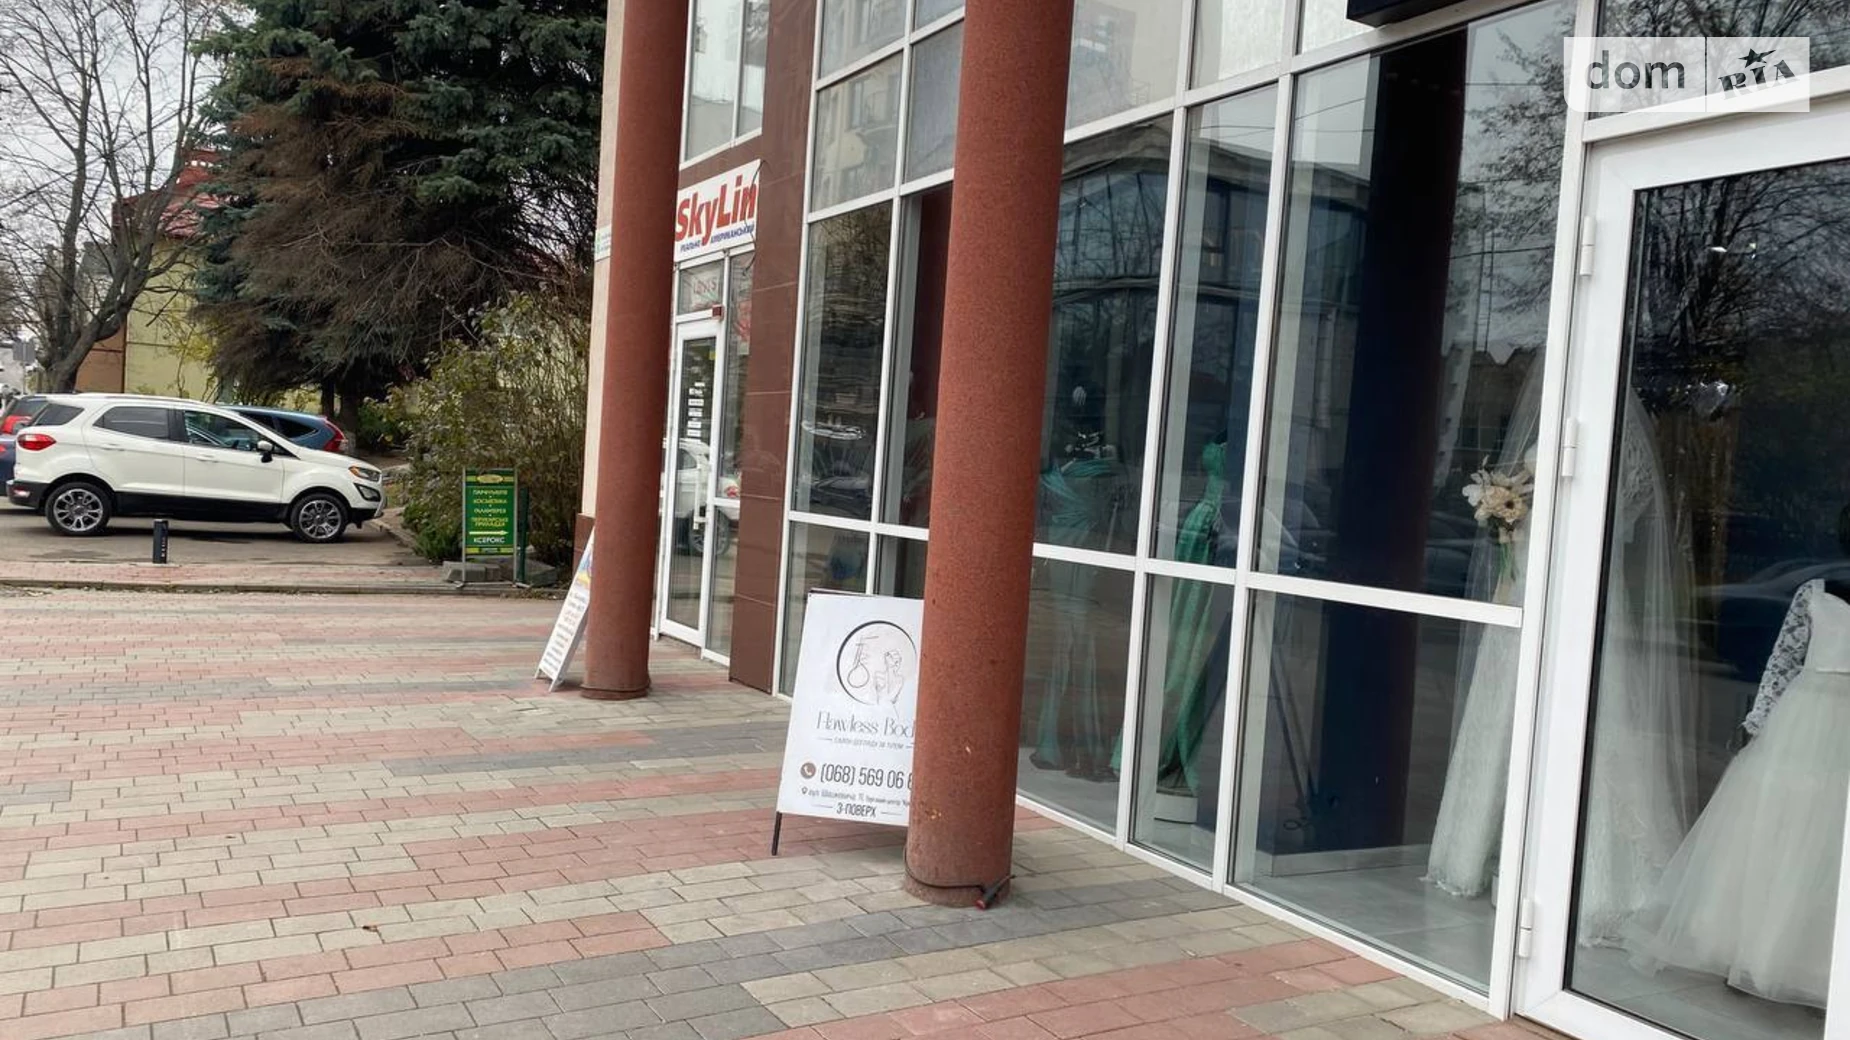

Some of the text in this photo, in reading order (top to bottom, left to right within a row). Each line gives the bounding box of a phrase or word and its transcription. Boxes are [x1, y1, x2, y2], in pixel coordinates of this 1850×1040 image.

[817, 711, 879, 734] Flawless
[820, 763, 856, 786] (068)
[859, 767, 884, 787] 569
[887, 769, 905, 789] 06
